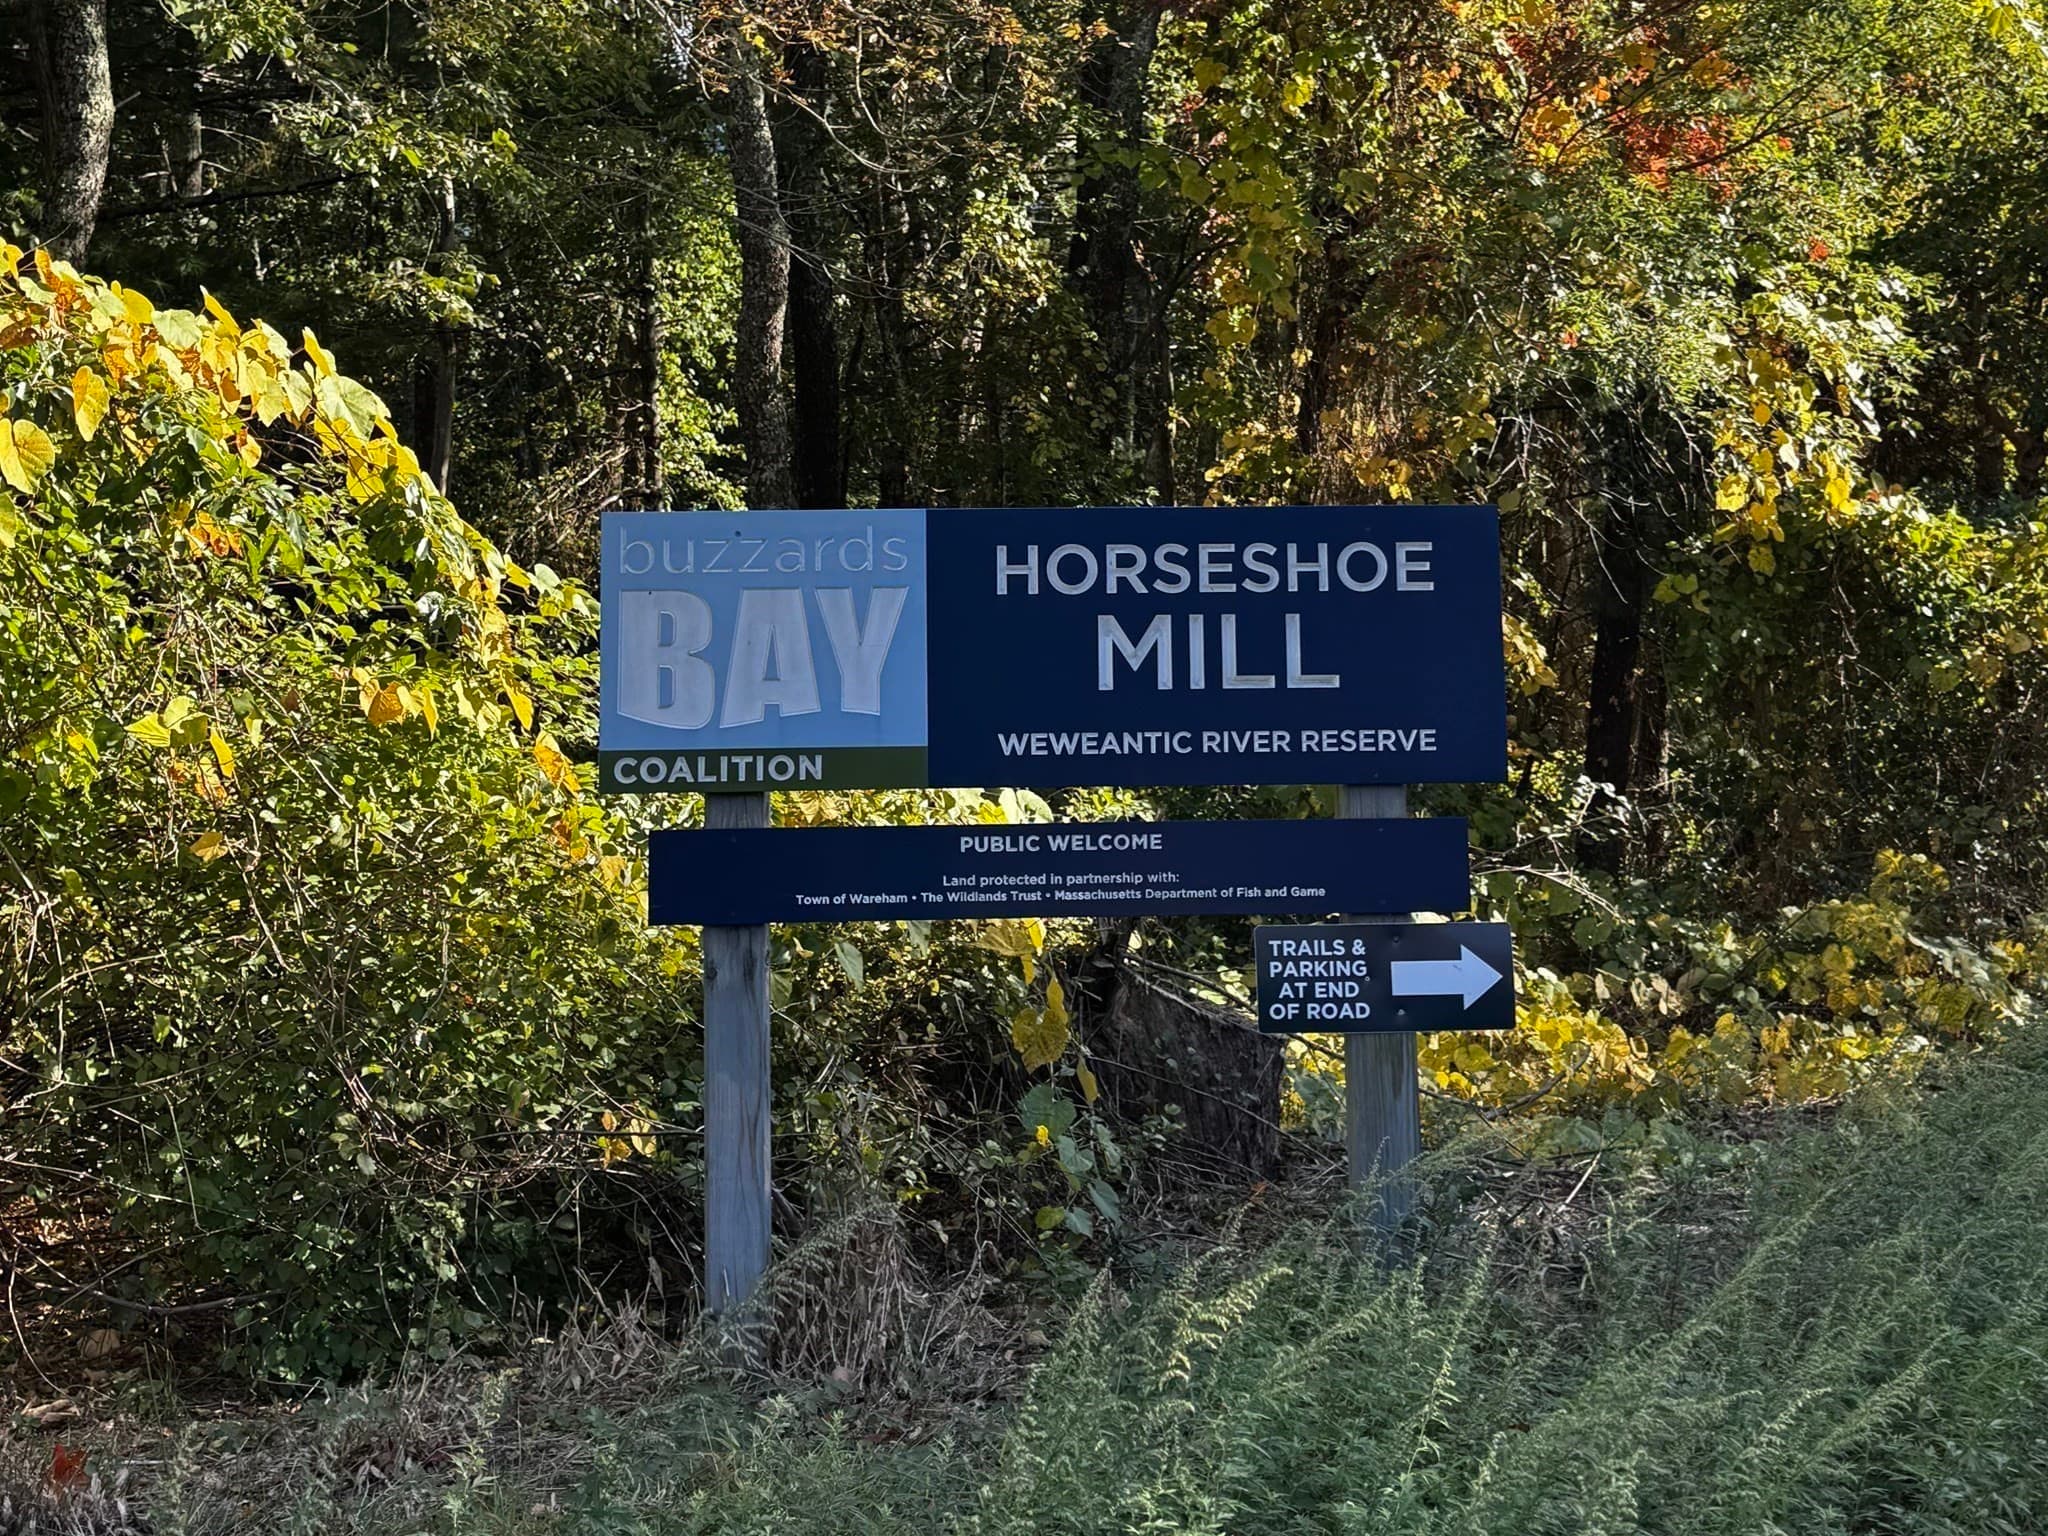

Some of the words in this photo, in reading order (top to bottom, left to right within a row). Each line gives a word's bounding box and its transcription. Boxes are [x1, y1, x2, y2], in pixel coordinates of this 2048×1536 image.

[620, 526, 908, 574] buzzards
[997, 542, 1434, 595] HORSESHOE
[617, 586, 909, 729] BAY
[1098, 614, 1340, 690] MILL
[998, 731, 1192, 755] WEWEANTIC
[1203, 731, 1291, 752] RIVER
[1302, 729, 1436, 752] RESERVE
[614, 755, 822, 784] COALITION
[961, 835, 1040, 852] PUBLIC
[1047, 834, 1162, 851] WELCOME
[943, 875, 975, 886] Land
[980, 873, 1046, 887] protected
[1051, 873, 1062, 884] in
[1067, 872, 1143, 886] partnership
[1148, 872, 1179, 882] with:
[796, 895, 829, 904] Town
[833, 894, 846, 904] of
[849, 893, 907, 904] Wareham
[921, 893, 943, 902] The
[947, 891, 1007, 901] Wildlands
[1010, 891, 1042, 900] Trust
[1055, 889, 1141, 900] Massachusetts
[1146, 888, 1217, 900] Department
[1221, 887, 1233, 897] of
[1237, 887, 1261, 897] Fish
[1265, 886, 1287, 897] and
[1291, 887, 1325, 896] Game
[1269, 939, 1345, 956] TRAILS
[1352, 939, 1365, 955] &
[1269, 960, 1367, 978] PARKING
[1279, 982, 1307, 998] AT
[1315, 982, 1359, 998] END
[1270, 1004, 1299, 1019] OF
[1307, 1003, 1370, 1019] ROAD
